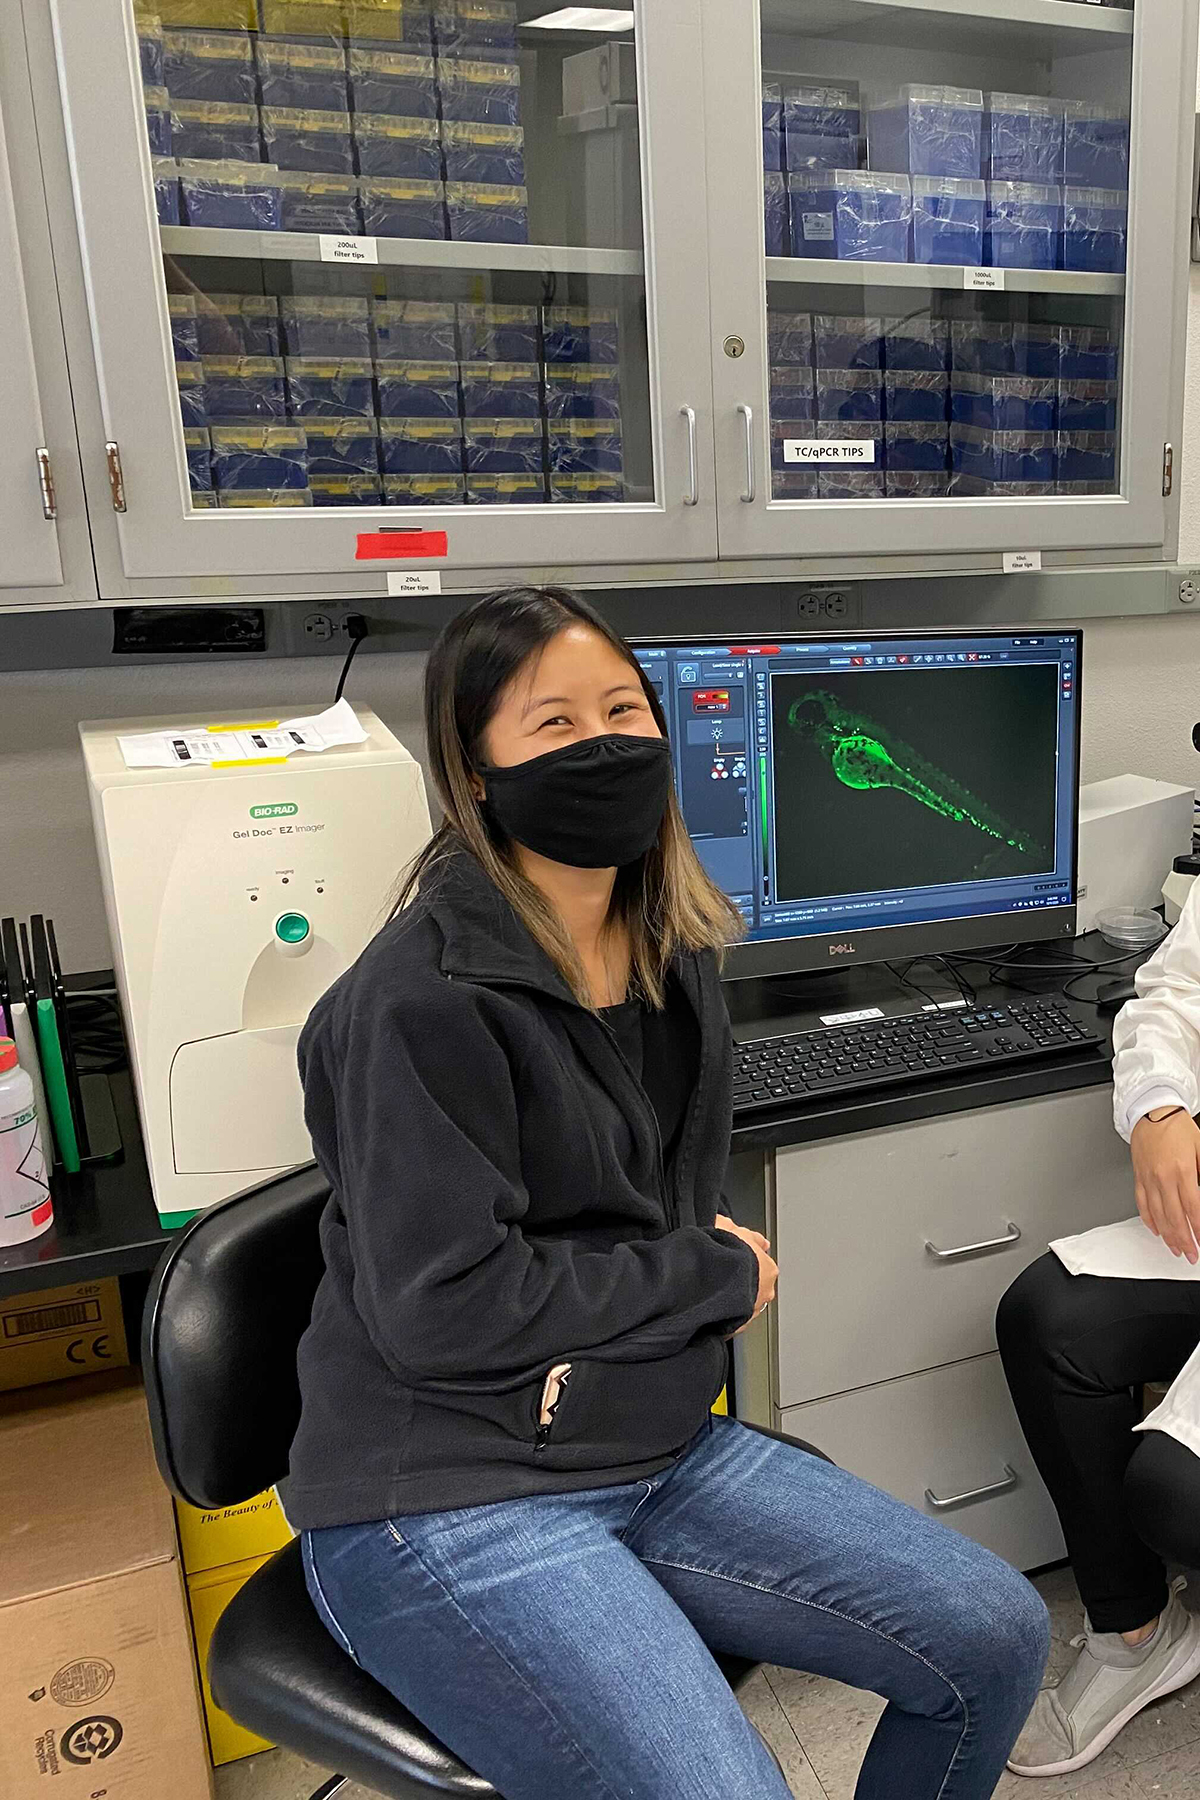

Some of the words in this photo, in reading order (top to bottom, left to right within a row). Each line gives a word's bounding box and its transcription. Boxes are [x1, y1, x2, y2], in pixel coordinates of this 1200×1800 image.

[337, 241, 358, 249] 200uL
[334, 250, 350, 258] filter
[352, 252, 365, 260] tips
[794, 447, 840, 459] TC/qPCR
[842, 447, 864, 457] TIPS
[254, 804, 296, 817] BIO-RAD
[232, 830, 250, 839] Gel
[279, 825, 294, 834] EZ
[295, 823, 326, 834] Imager
[829, 943, 856, 956] DELL
[13, 1110, 32, 1126] 70%
[66, 1334, 112, 1364] CE
[200, 1514, 221, 1525] The
[223, 1503, 260, 1519] Beauty
[261, 1498, 275, 1511] of
[34, 1735, 48, 1775] Recycles
[44, 1728, 62, 1776] Corrugated
